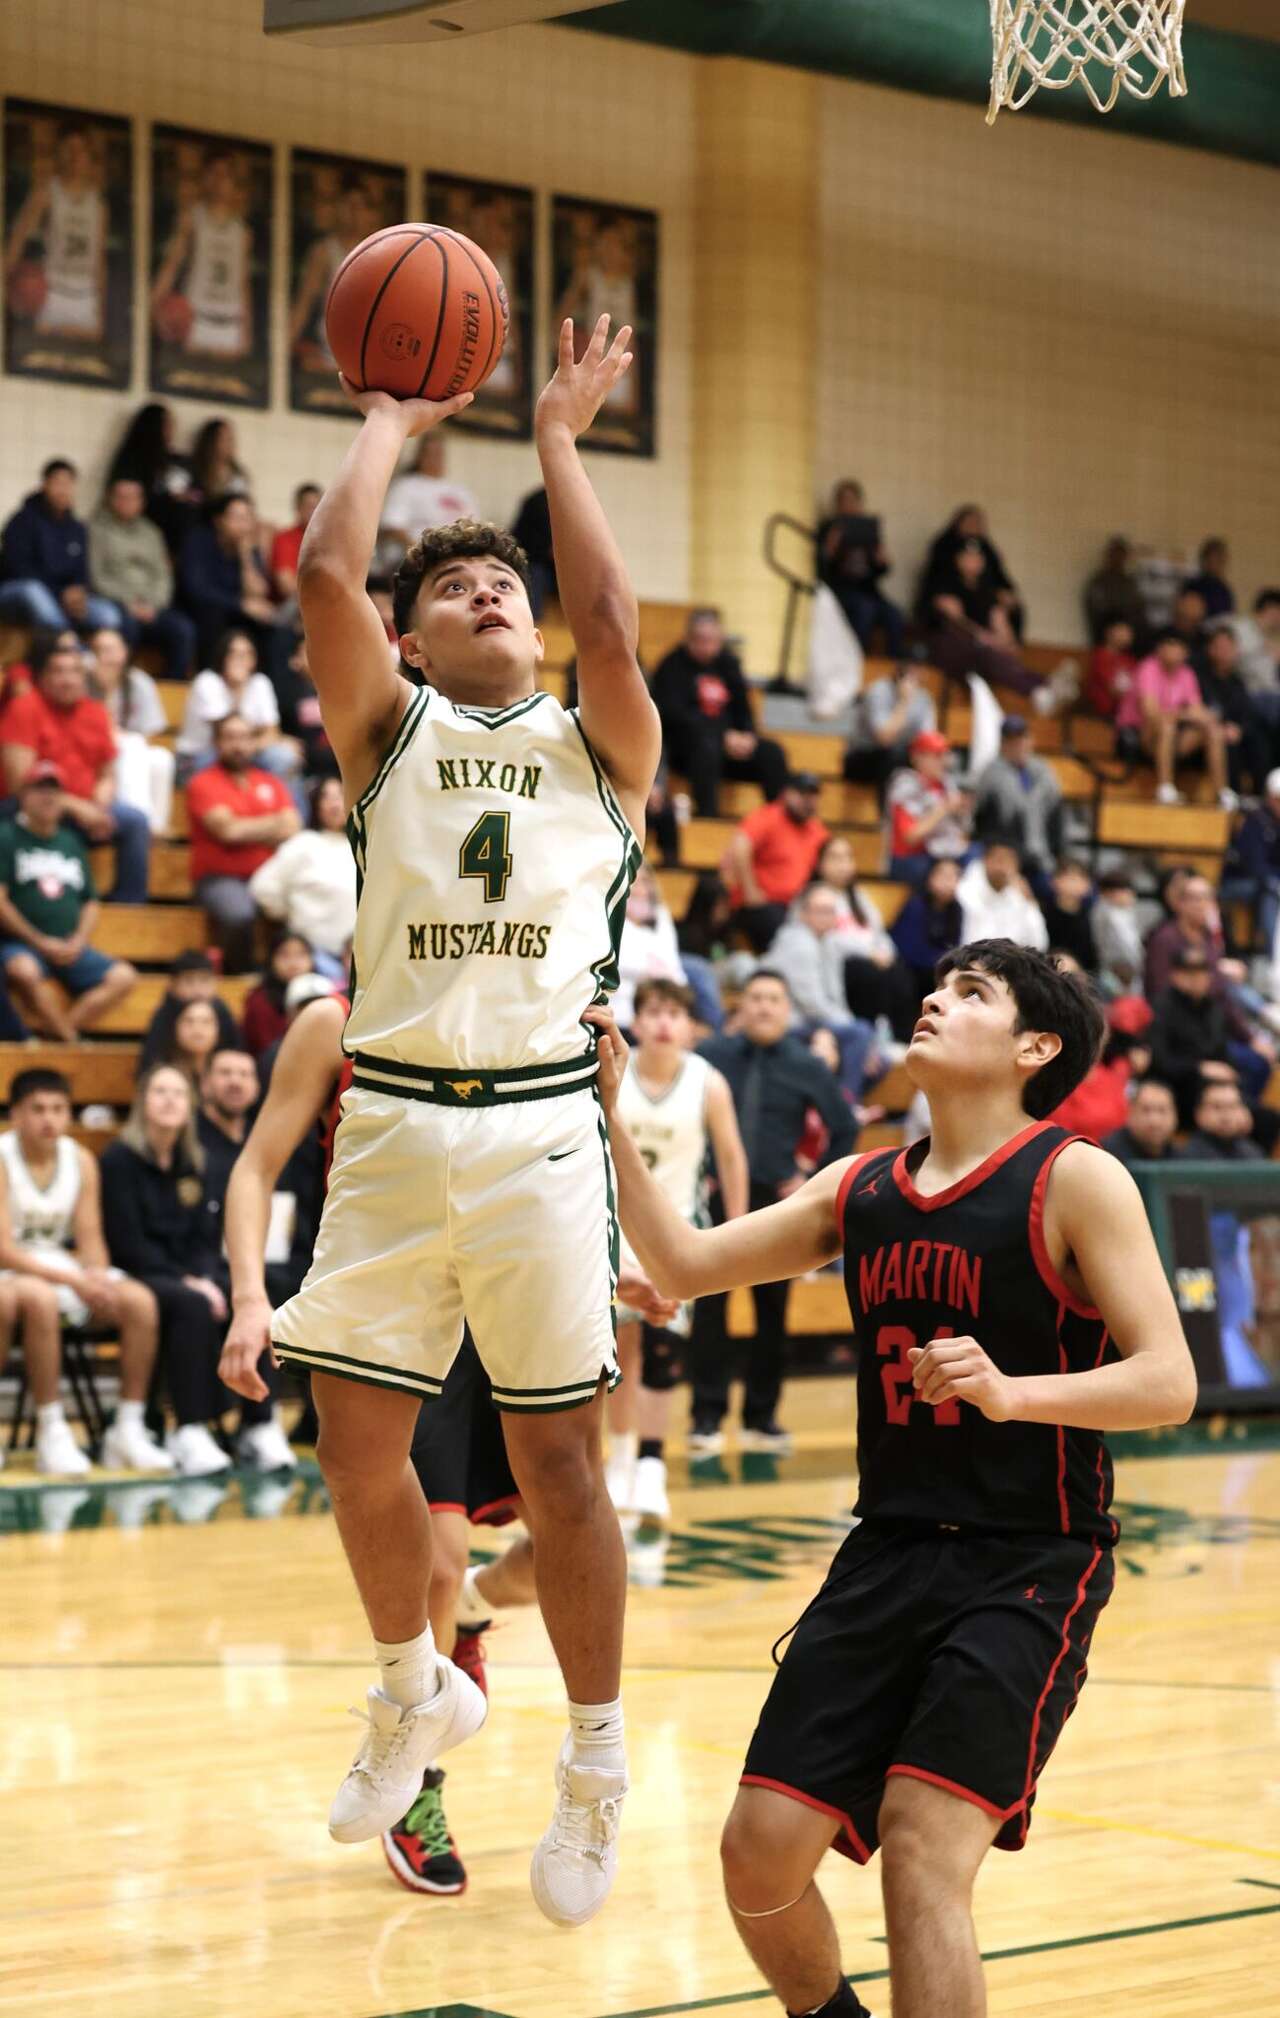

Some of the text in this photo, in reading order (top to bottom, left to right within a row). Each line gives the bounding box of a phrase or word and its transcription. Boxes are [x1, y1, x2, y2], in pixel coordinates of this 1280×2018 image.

[436, 759, 542, 799] NIXON
[458, 810, 513, 903] 4
[408, 921, 551, 960] MUSTANGS
[859, 1240, 982, 1319] MARTIN
